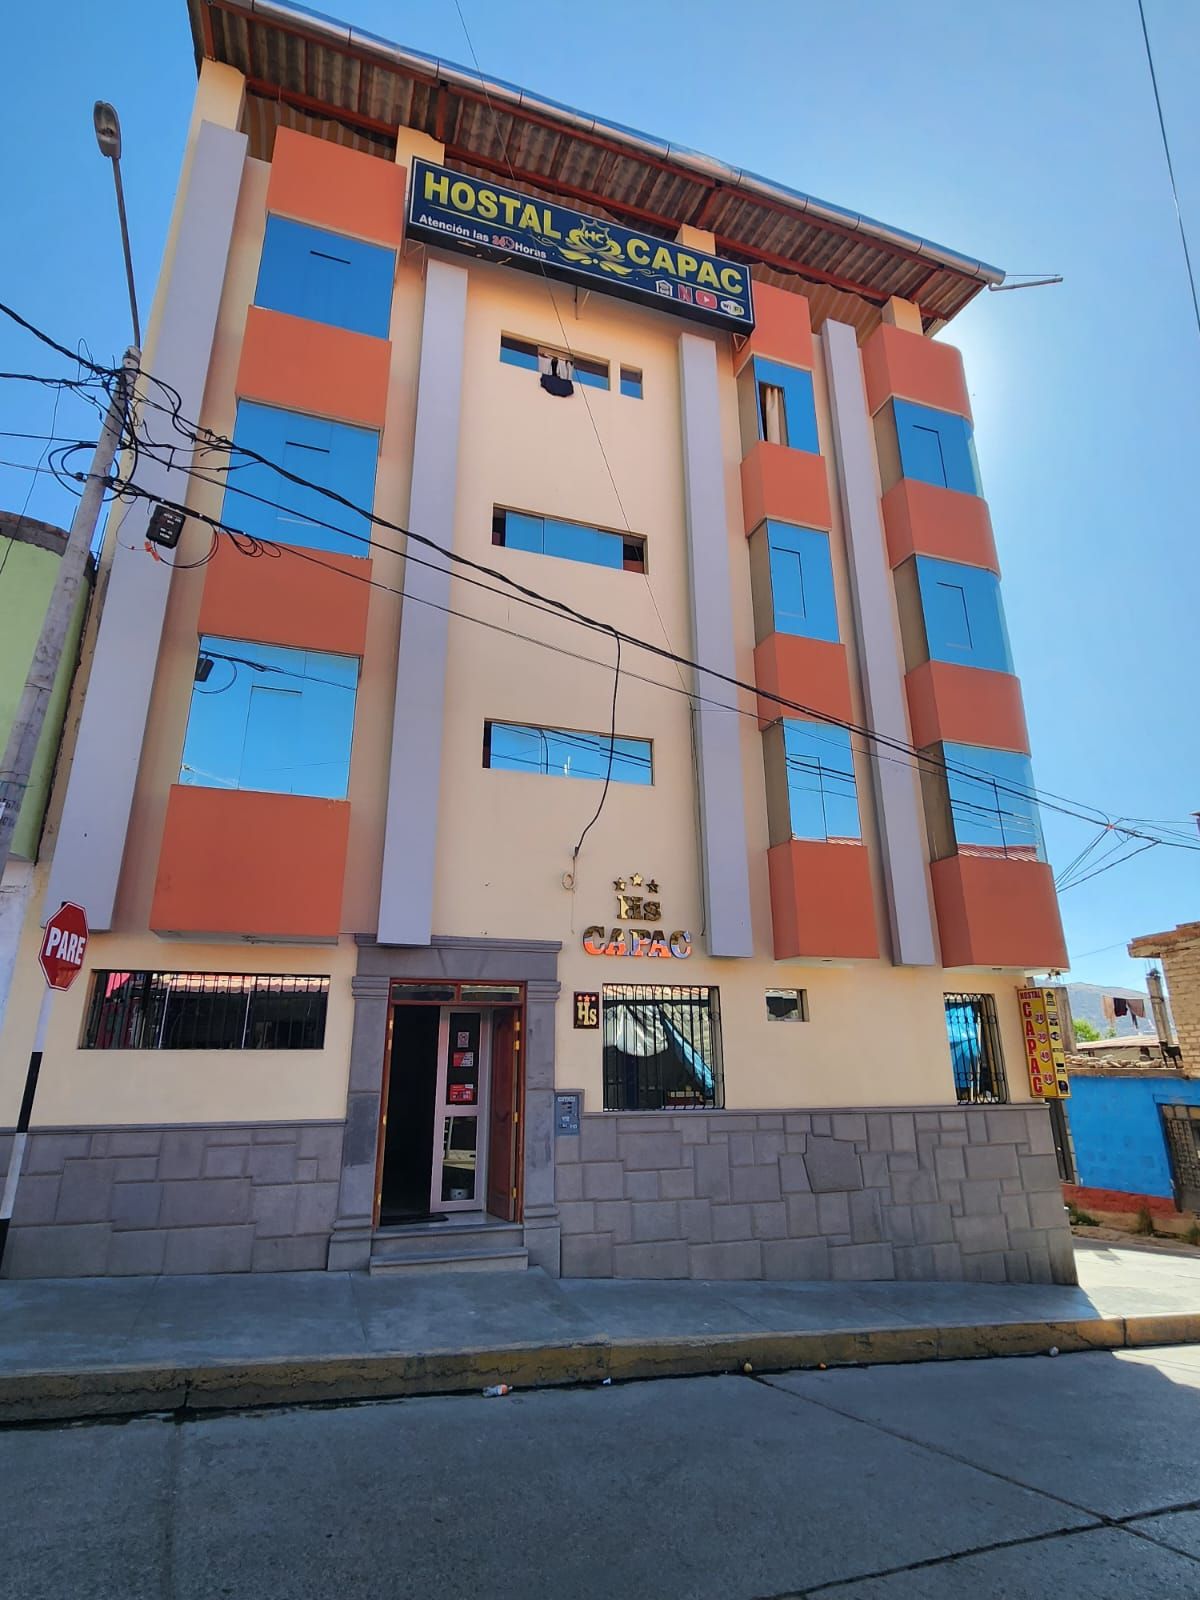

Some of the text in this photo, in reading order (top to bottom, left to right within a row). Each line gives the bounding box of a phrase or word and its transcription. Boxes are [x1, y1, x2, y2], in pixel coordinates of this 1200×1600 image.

[419, 214, 470, 237] Atención
[473, 229, 489, 242] las
[515, 243, 547, 259] Horas
[424, 171, 744, 294] HOSTAL CAPAC
[584, 230, 604, 244] HC
[617, 895, 662, 921] Hs
[45, 926, 86, 965] PARE
[583, 925, 693, 959] CAPAC
[577, 1001, 597, 1025] Hs
[1022, 1002, 1043, 1094] CAPAC
